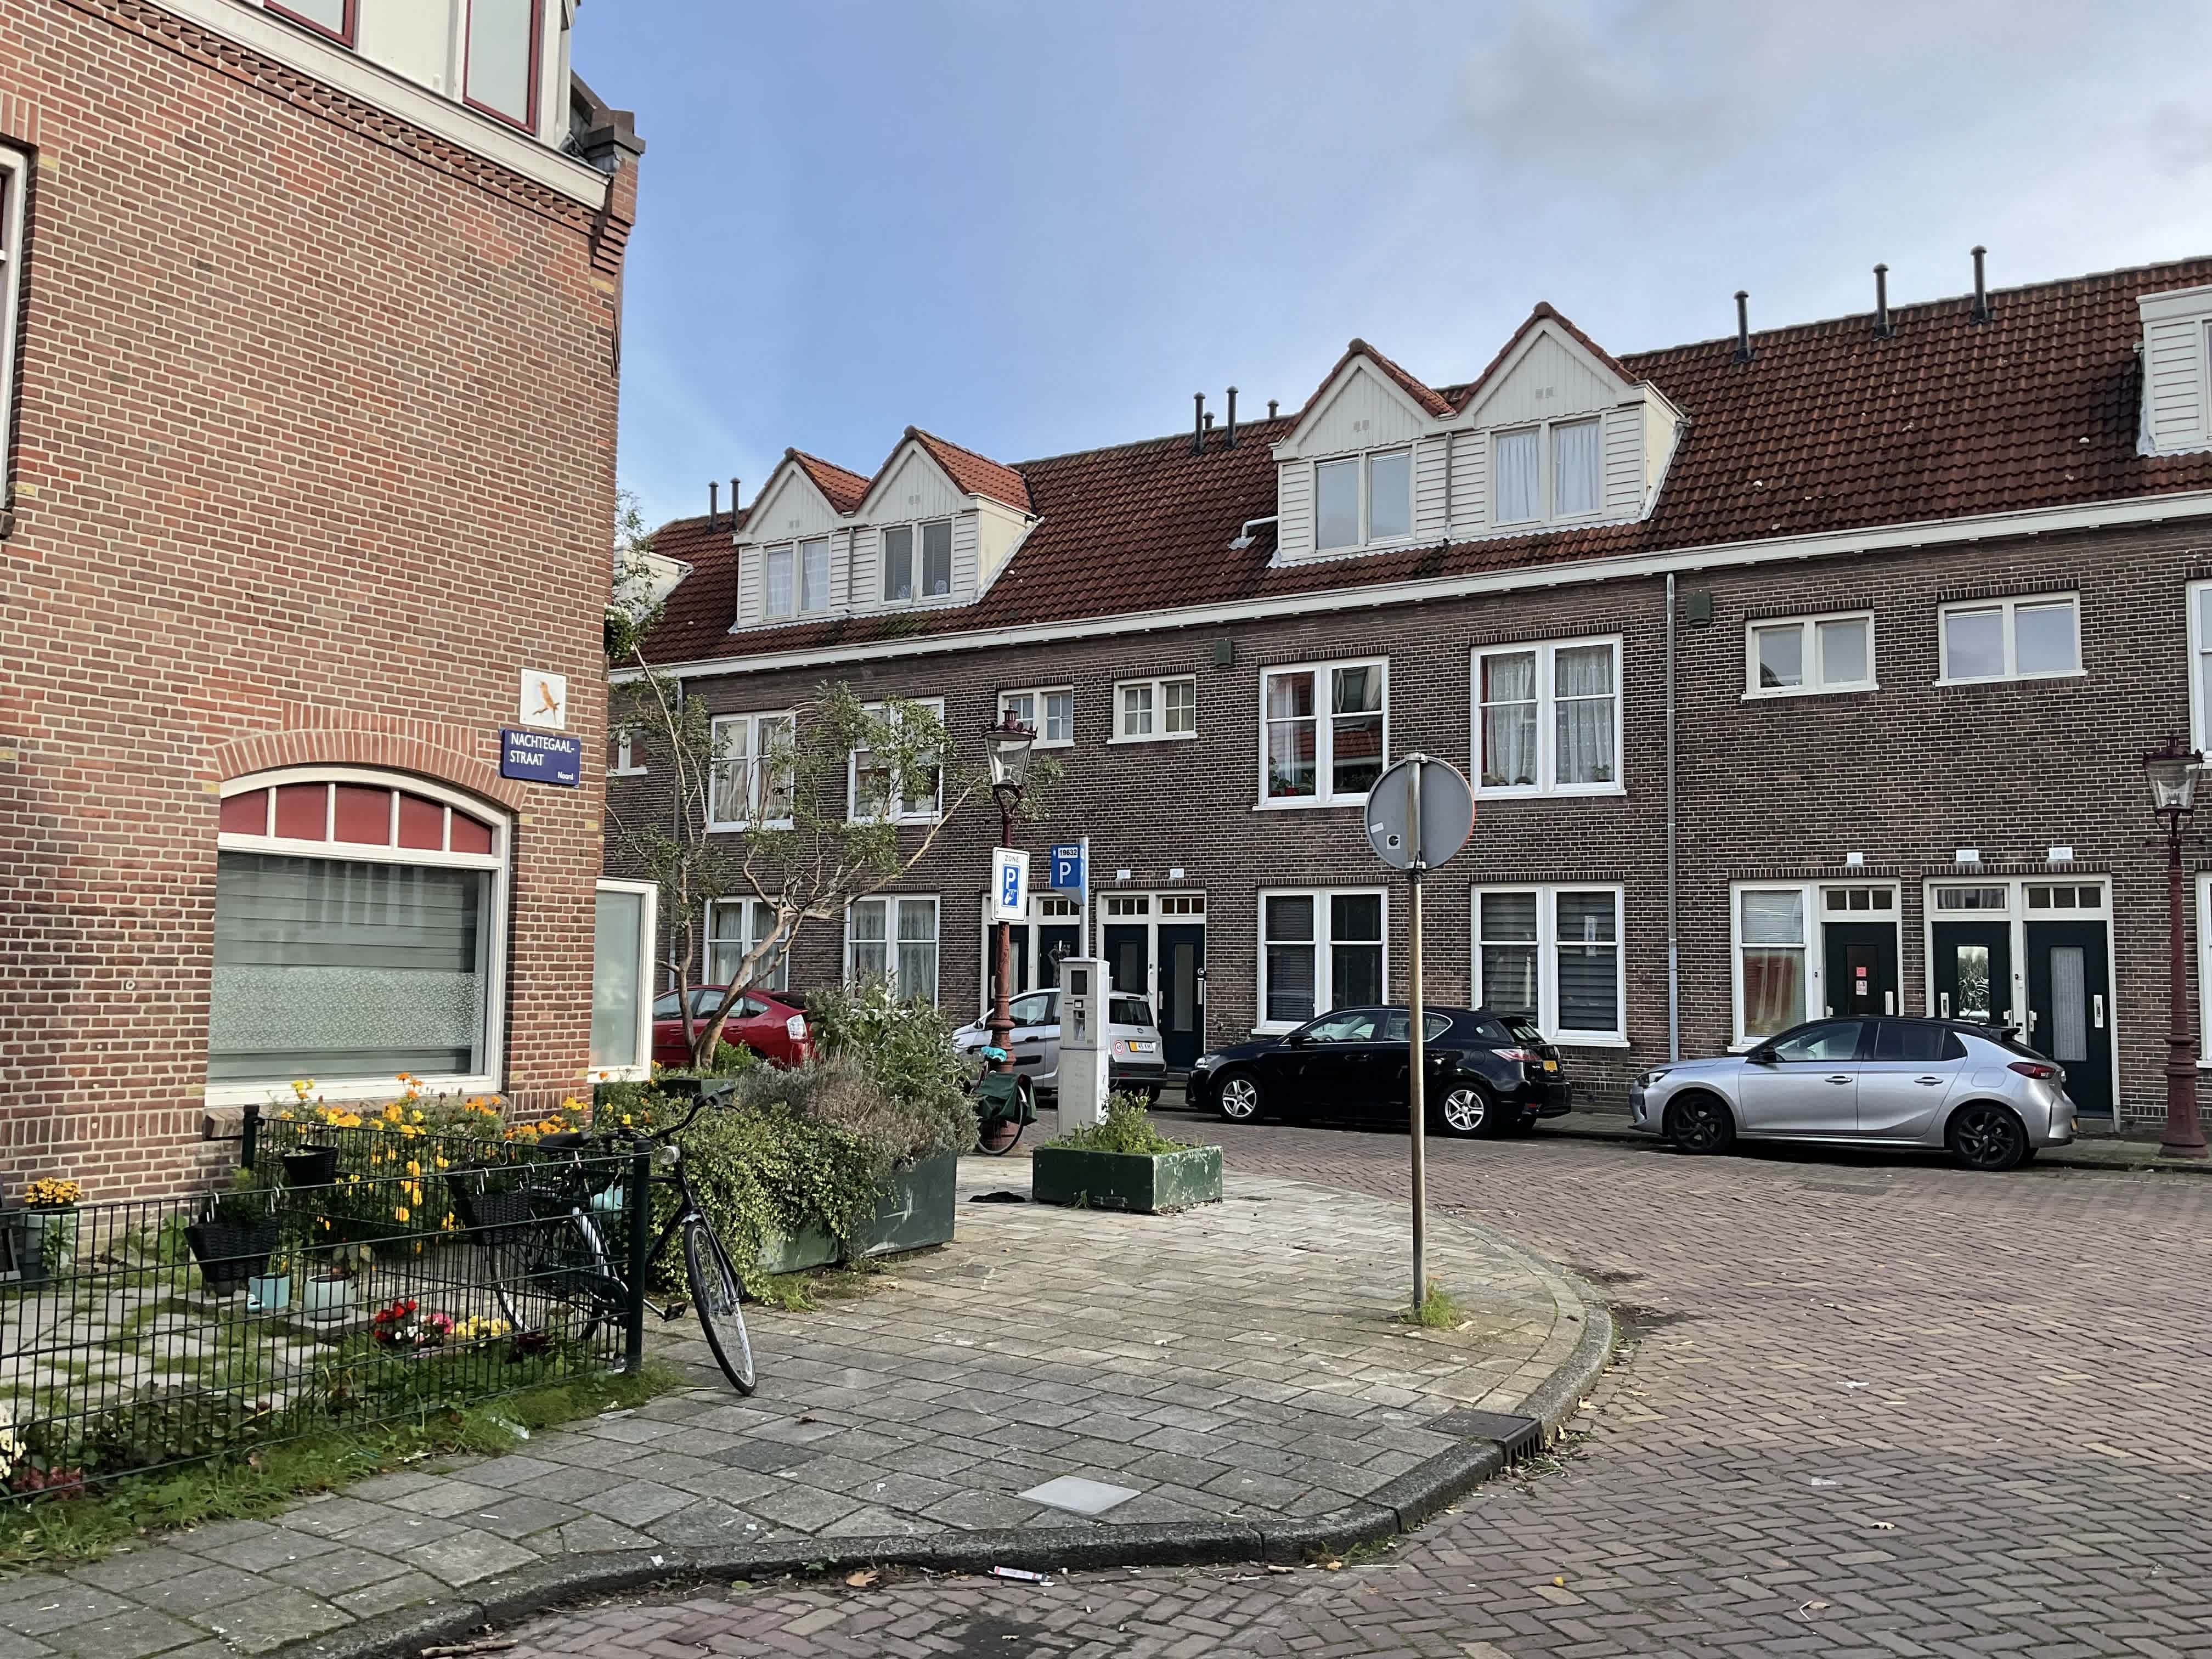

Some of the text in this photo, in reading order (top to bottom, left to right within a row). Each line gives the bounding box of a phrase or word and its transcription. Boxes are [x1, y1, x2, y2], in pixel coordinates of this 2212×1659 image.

[511, 732, 574, 753] NACHTEGAAL-
[510, 751, 544, 766] STRAAT
[557, 771, 574, 780] Noord
[1005, 855, 1019, 863] ZONE
[1006, 868, 1016, 889] P
[1059, 861, 1071, 884] P
